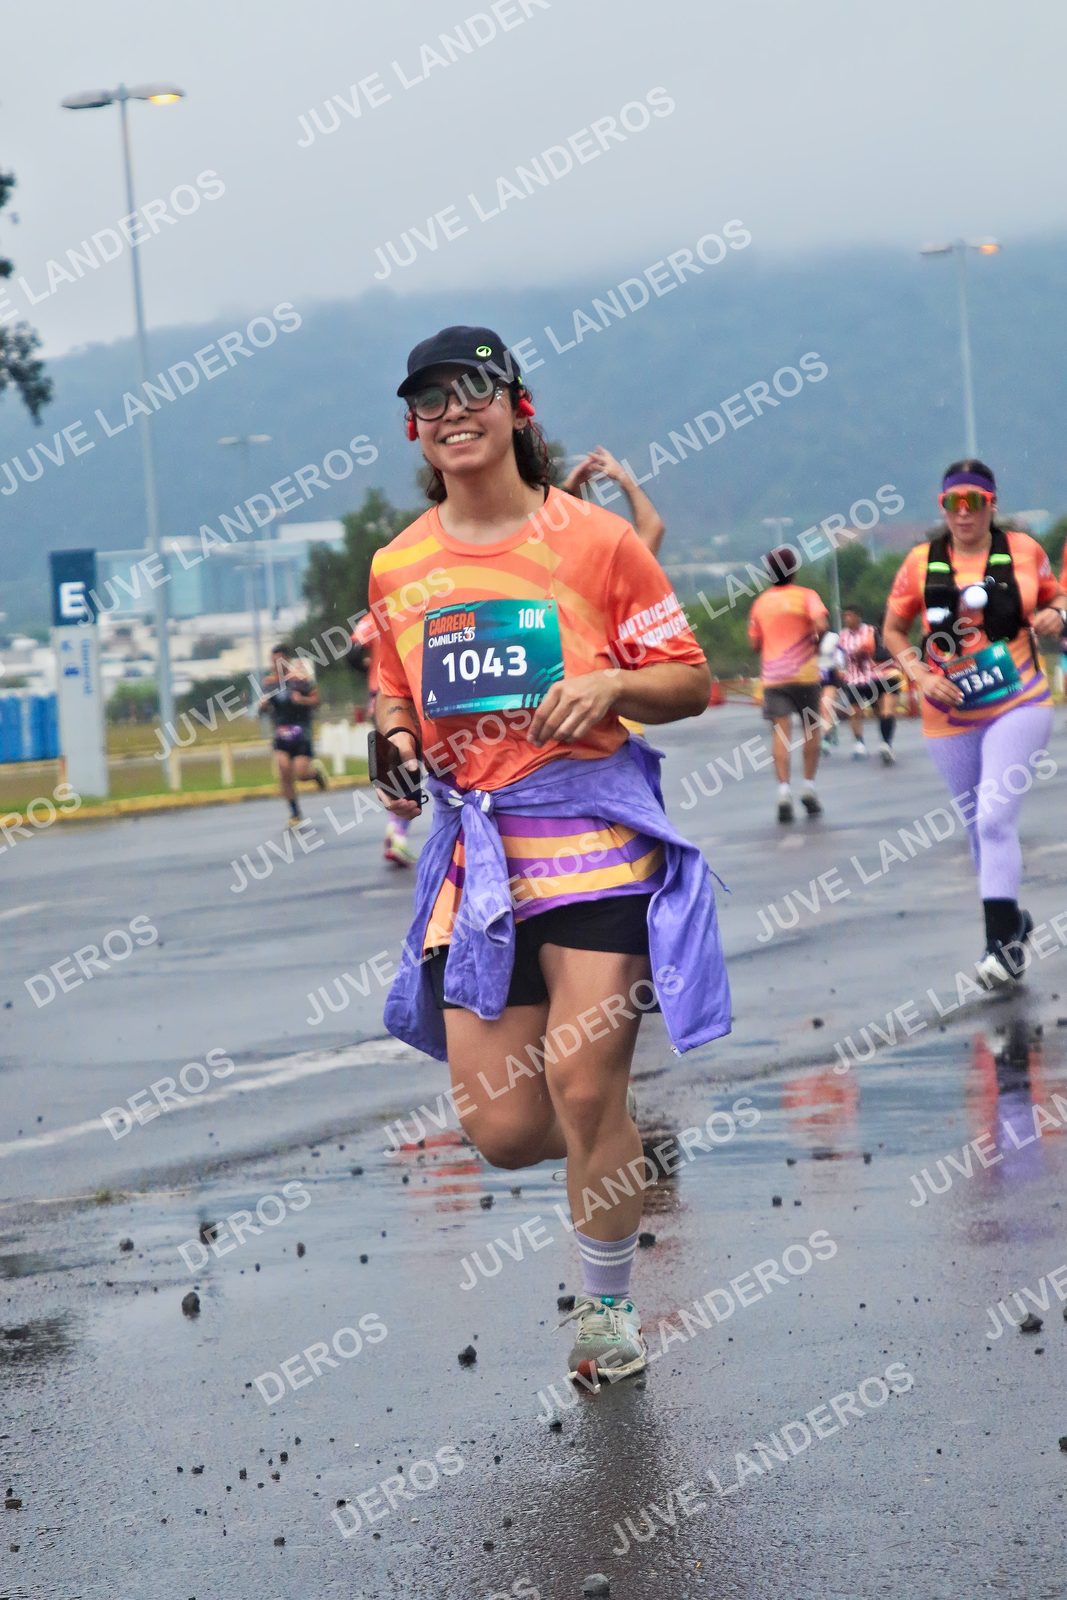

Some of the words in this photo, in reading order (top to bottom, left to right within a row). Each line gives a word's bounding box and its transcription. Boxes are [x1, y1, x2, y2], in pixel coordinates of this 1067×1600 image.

[59, 581, 86, 618] E
[429, 611, 475, 636] CARRERA
[518, 608, 546, 629] 10K
[442, 645, 528, 683] 1043
